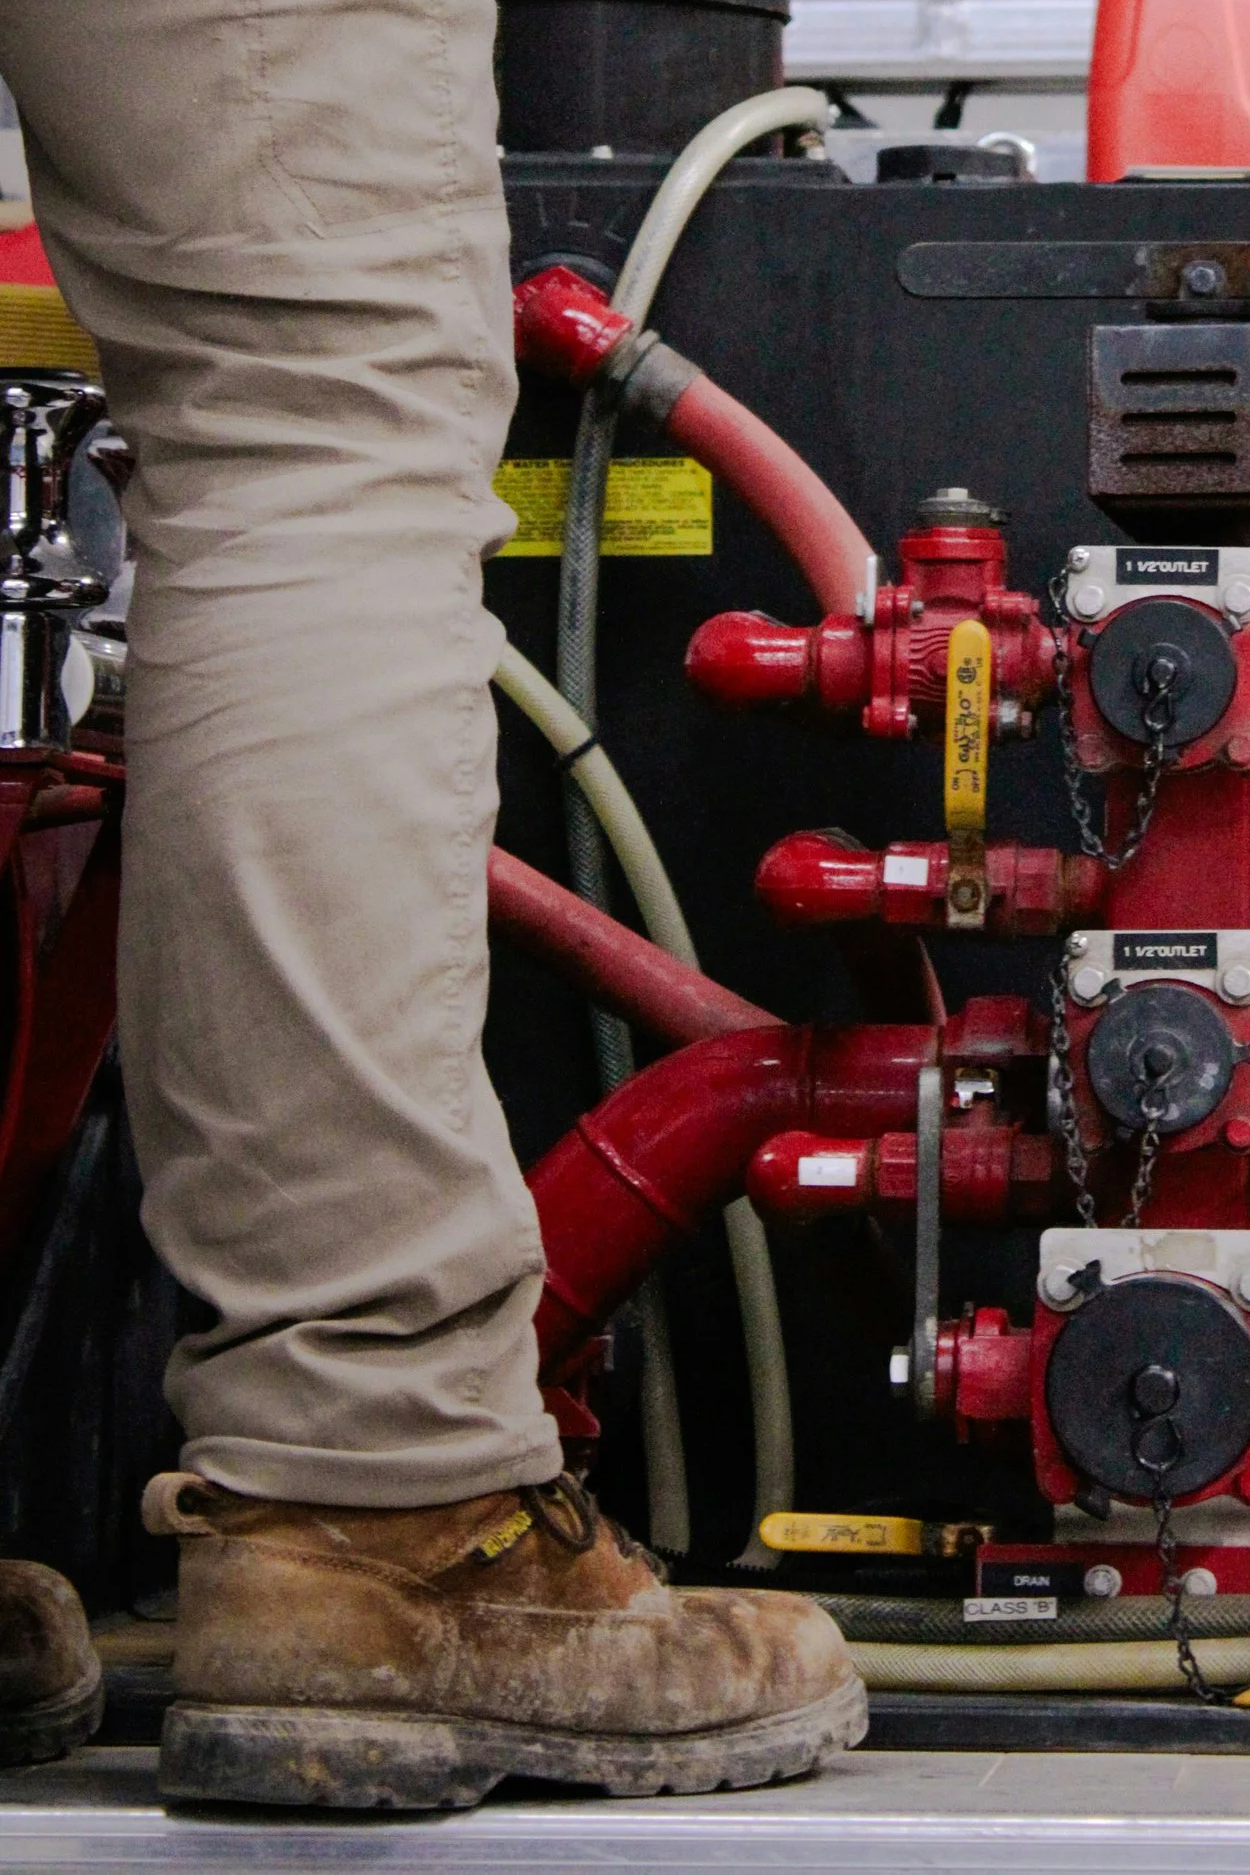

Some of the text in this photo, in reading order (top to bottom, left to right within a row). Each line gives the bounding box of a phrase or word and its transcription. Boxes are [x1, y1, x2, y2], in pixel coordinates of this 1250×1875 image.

[1125, 561, 1133, 572] 1
[951, 777, 960, 790] ON
[972, 776, 980, 793] OFF
[1123, 946, 1131, 957] 1
[1013, 1575, 1050, 1587] DRAIN
[965, 1601, 1028, 1616] CLASS
